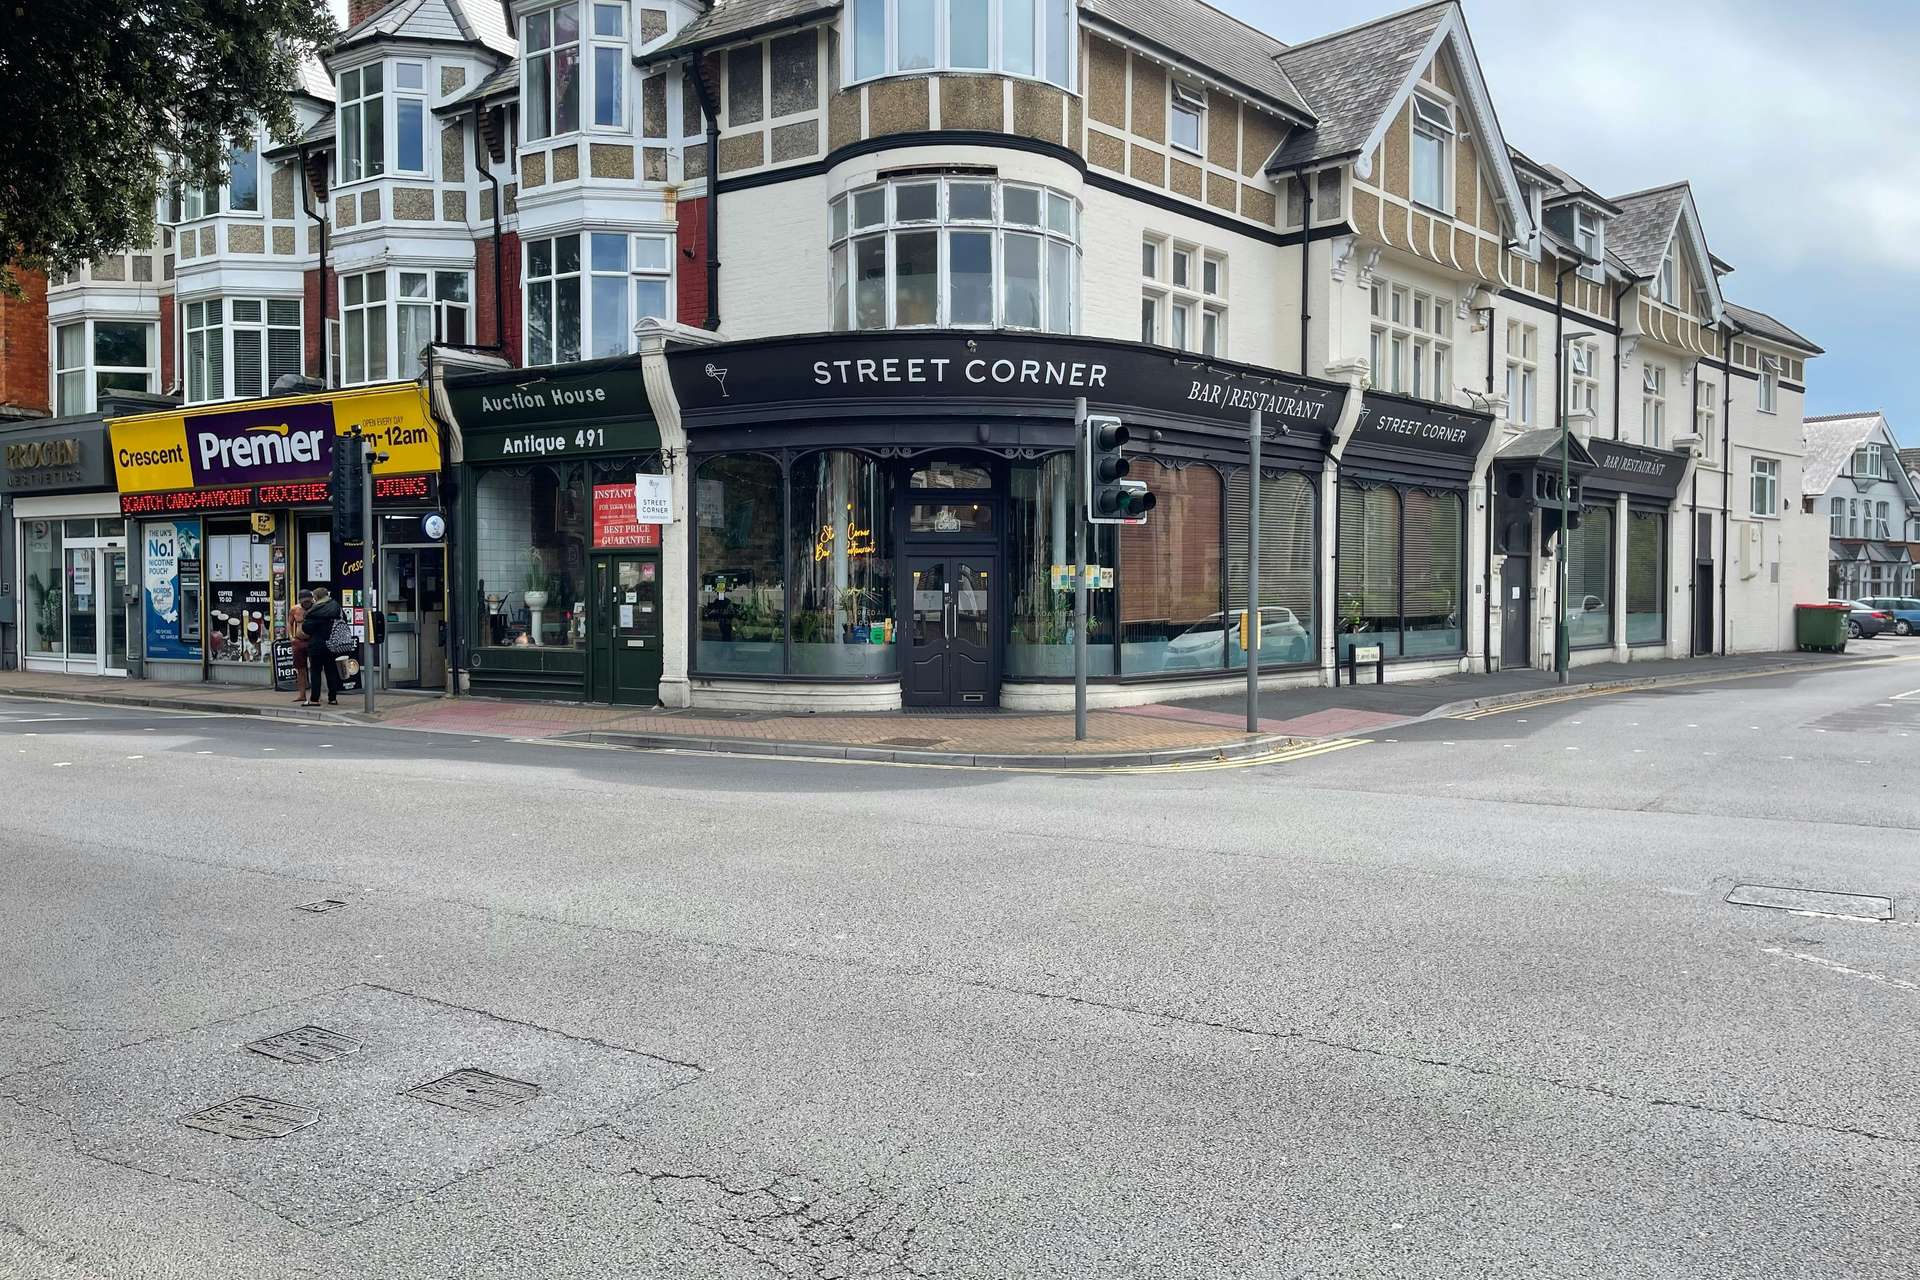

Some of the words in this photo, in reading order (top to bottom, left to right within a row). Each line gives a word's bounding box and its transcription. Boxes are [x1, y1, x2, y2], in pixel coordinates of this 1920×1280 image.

[813, 358, 950, 385] STREET
[965, 359, 1107, 388] CORNER
[482, 392, 545, 412] Auction
[551, 388, 605, 406] House
[363, 418, 376, 427] OPEN
[377, 417, 392, 426] EVERY
[393, 416, 404, 424] DAY
[1376, 415, 1422, 436] STREET
[1422, 424, 1467, 443] CORNER
[343, 426, 428, 448] m-12am
[502, 434, 566, 455] Antique
[575, 428, 604, 448] 491
[119, 444, 184, 468] Crescent
[198, 429, 324, 471] Premier
[375, 476, 428, 497] DRINKS
[594, 488, 633, 499] INSTANT
[123, 494, 165, 513] SCRATCH
[604, 525, 625, 534] BEST
[626, 524, 650, 533] PRICE
[149, 538, 174, 557] No.1
[602, 535, 652, 545] GUARANTEE
[149, 559, 174, 567] NICOTINE
[277, 645, 293, 656] fre
